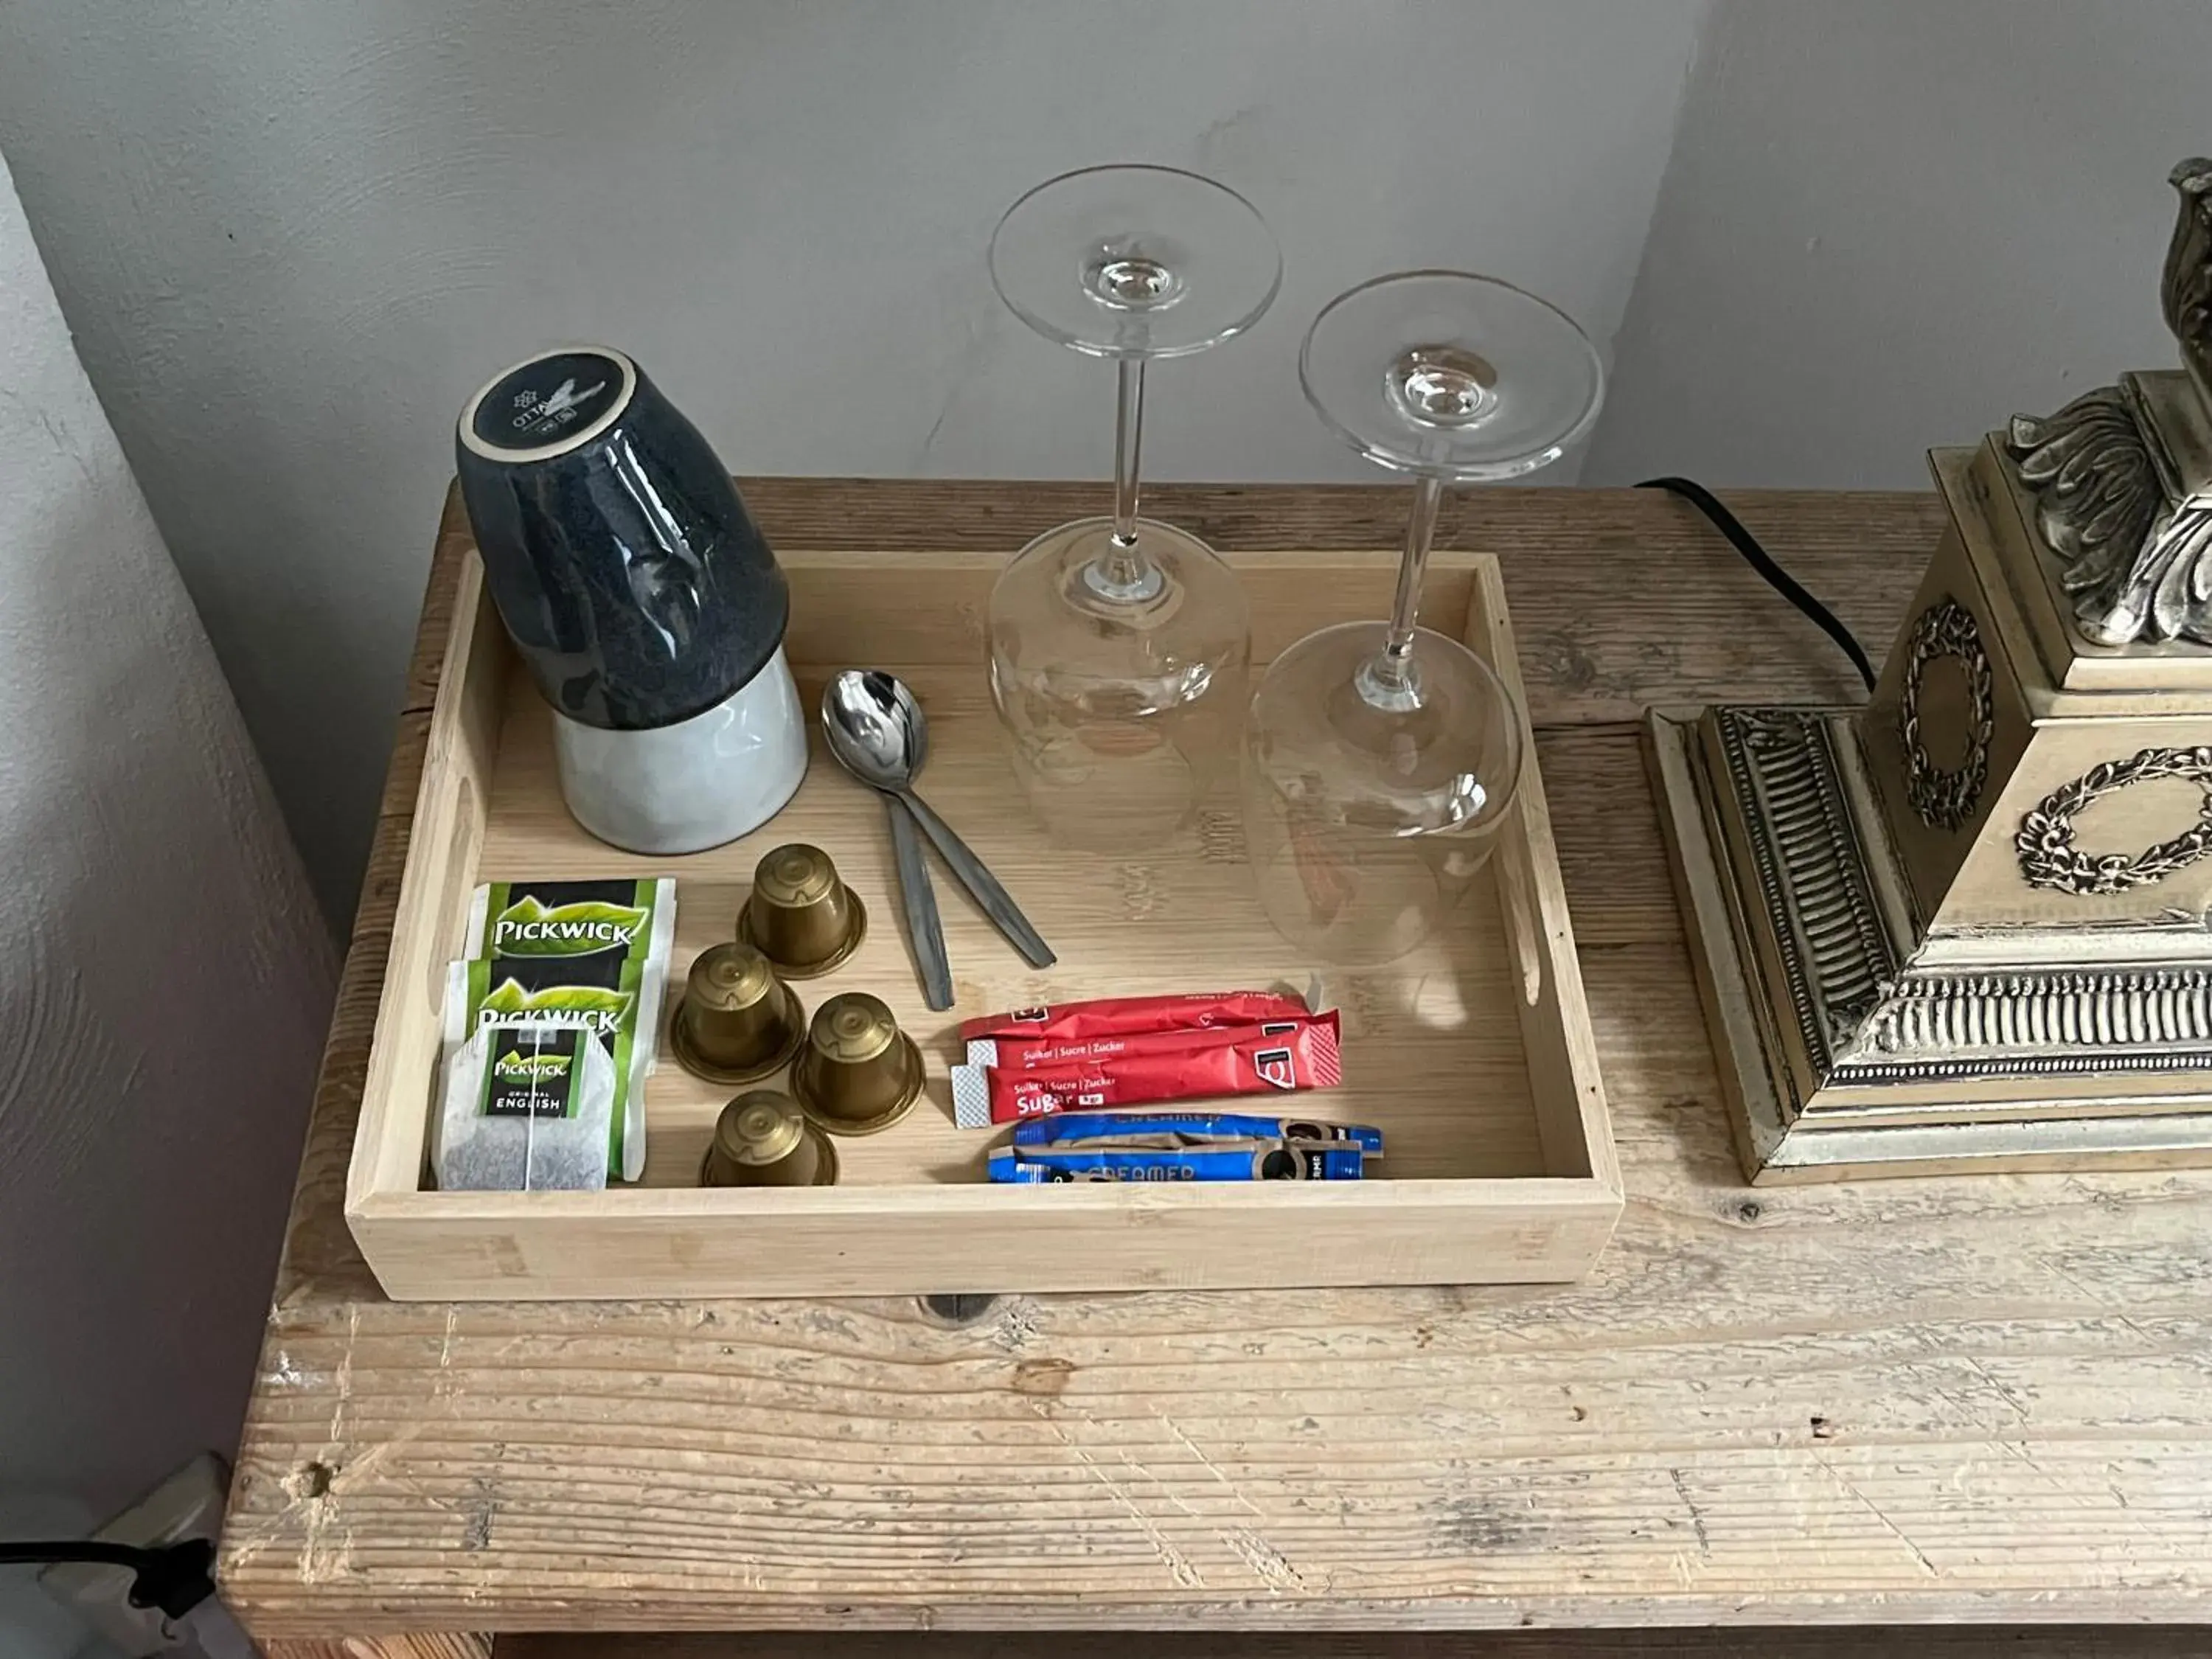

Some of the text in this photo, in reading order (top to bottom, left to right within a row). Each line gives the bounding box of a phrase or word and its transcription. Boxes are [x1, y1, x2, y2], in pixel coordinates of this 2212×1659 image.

[495, 921, 631, 945] PICKWICK
[1060, 1045, 1086, 1057] Sucre
[1093, 1041, 1125, 1054] Zucker
[495, 1062, 567, 1076] PICKWICK
[1017, 1093, 1074, 1115] Sugar
